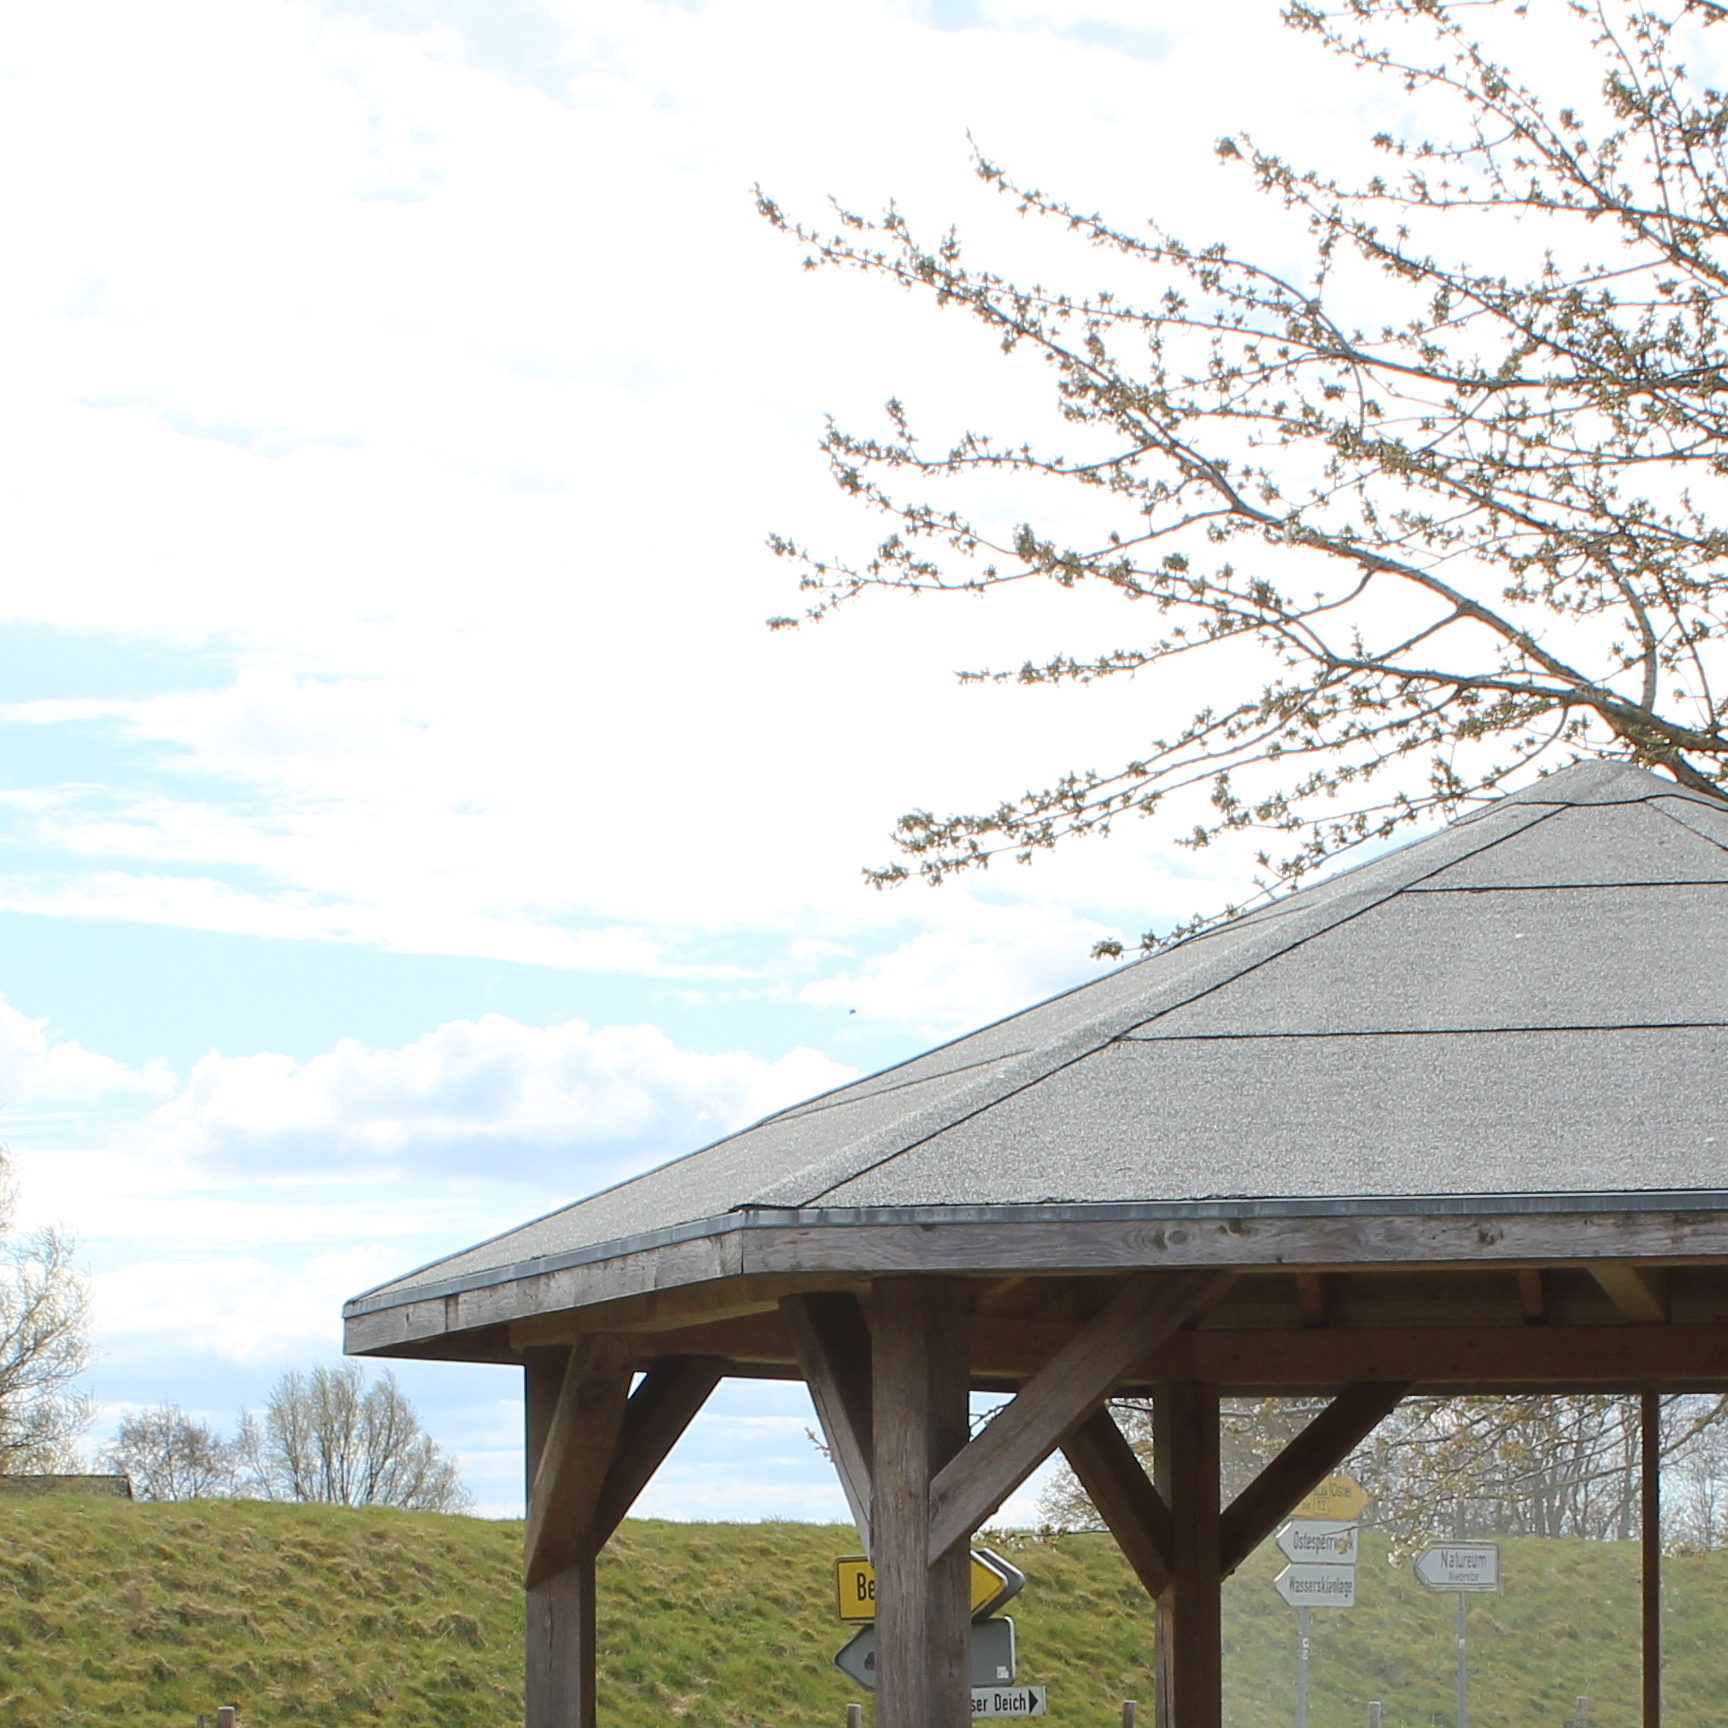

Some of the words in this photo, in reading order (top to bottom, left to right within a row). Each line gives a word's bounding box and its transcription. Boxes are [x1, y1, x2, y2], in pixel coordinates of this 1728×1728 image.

[1440, 1550, 1487, 1568] Natureum
[1289, 1576, 1353, 1598] Wasserskianlage
[994, 1693, 1026, 1711] Deich
